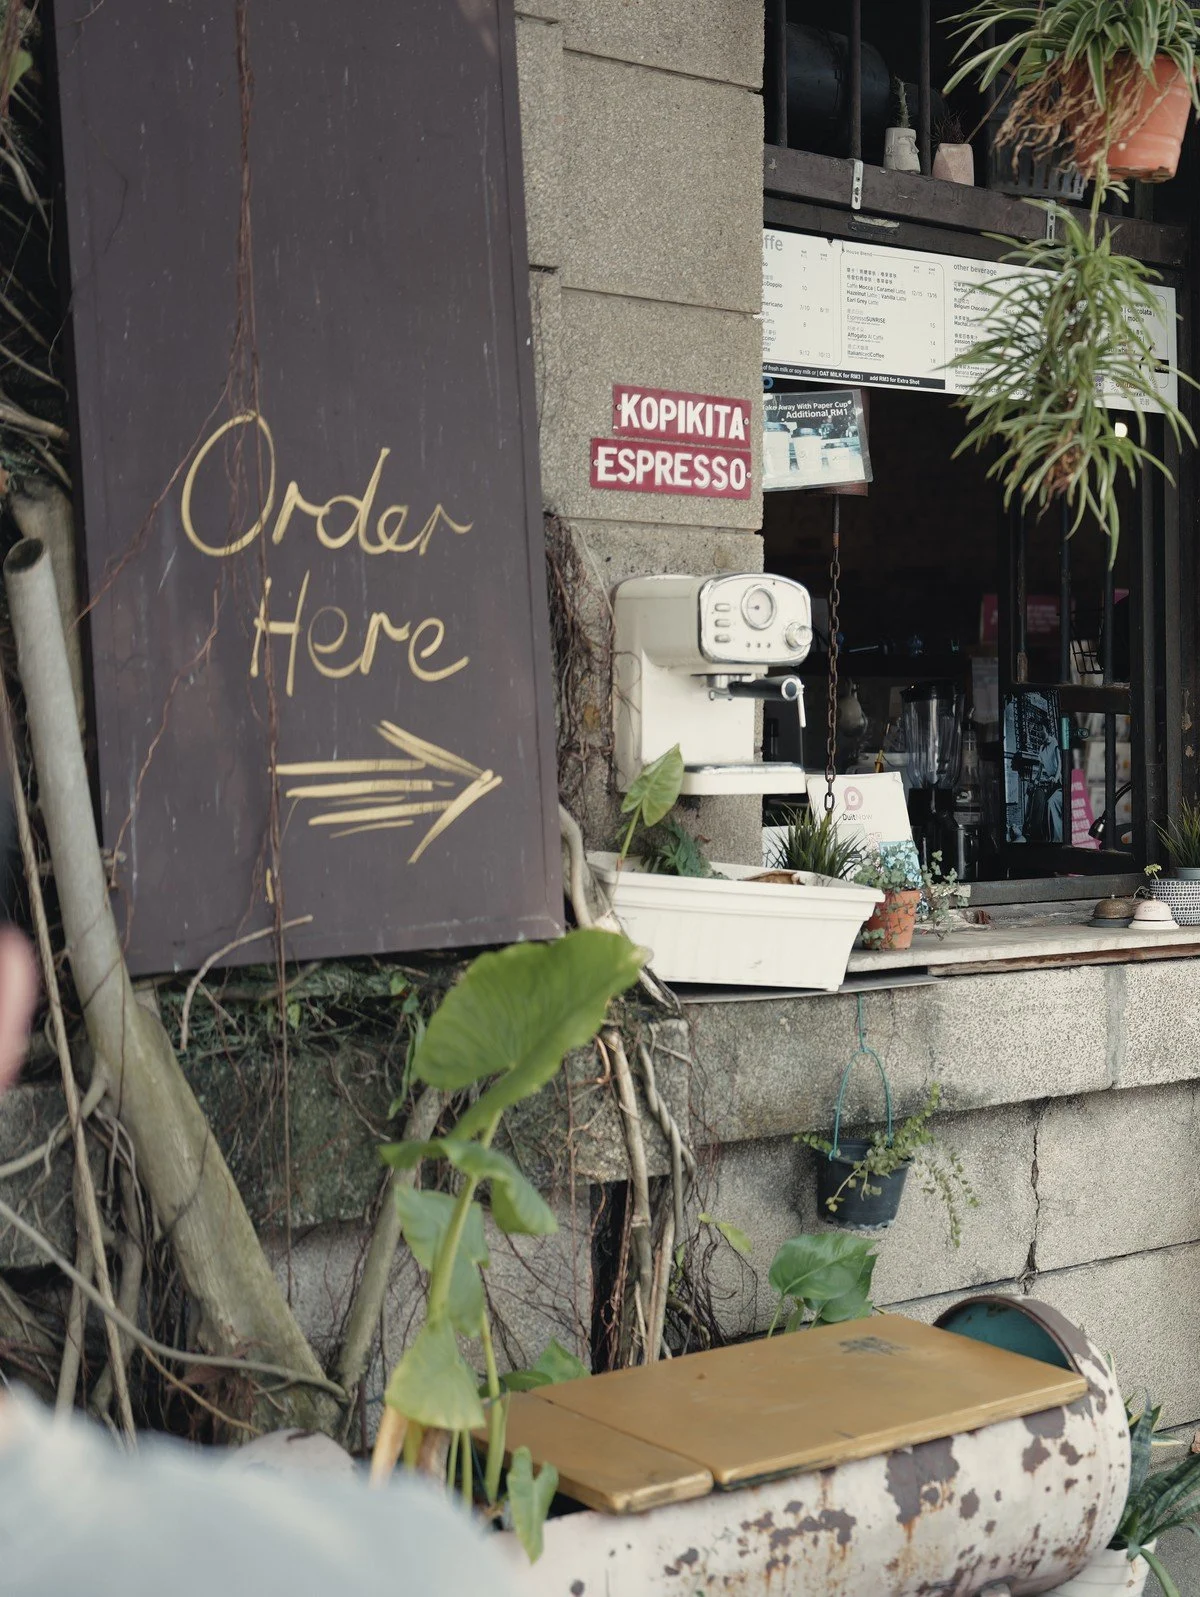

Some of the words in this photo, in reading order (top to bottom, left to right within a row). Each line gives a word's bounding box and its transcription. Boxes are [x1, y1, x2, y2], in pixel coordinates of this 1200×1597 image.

[763, 234, 784, 251] ffe
[953, 264, 969, 272] other
[970, 266, 997, 276] beverage
[876, 286, 895, 294] Caramel
[794, 368, 802, 376] soy
[813, 402, 833, 410] Paper
[834, 401, 848, 409] Cup
[620, 392, 746, 441] KOPIKITA
[785, 410, 829, 419] Additional
[830, 408, 848, 416] RM1
[596, 446, 747, 491] ESPRESSO
[181, 409, 475, 557] Order
[250, 569, 470, 697] Here
[842, 813, 873, 821] DuitNow
